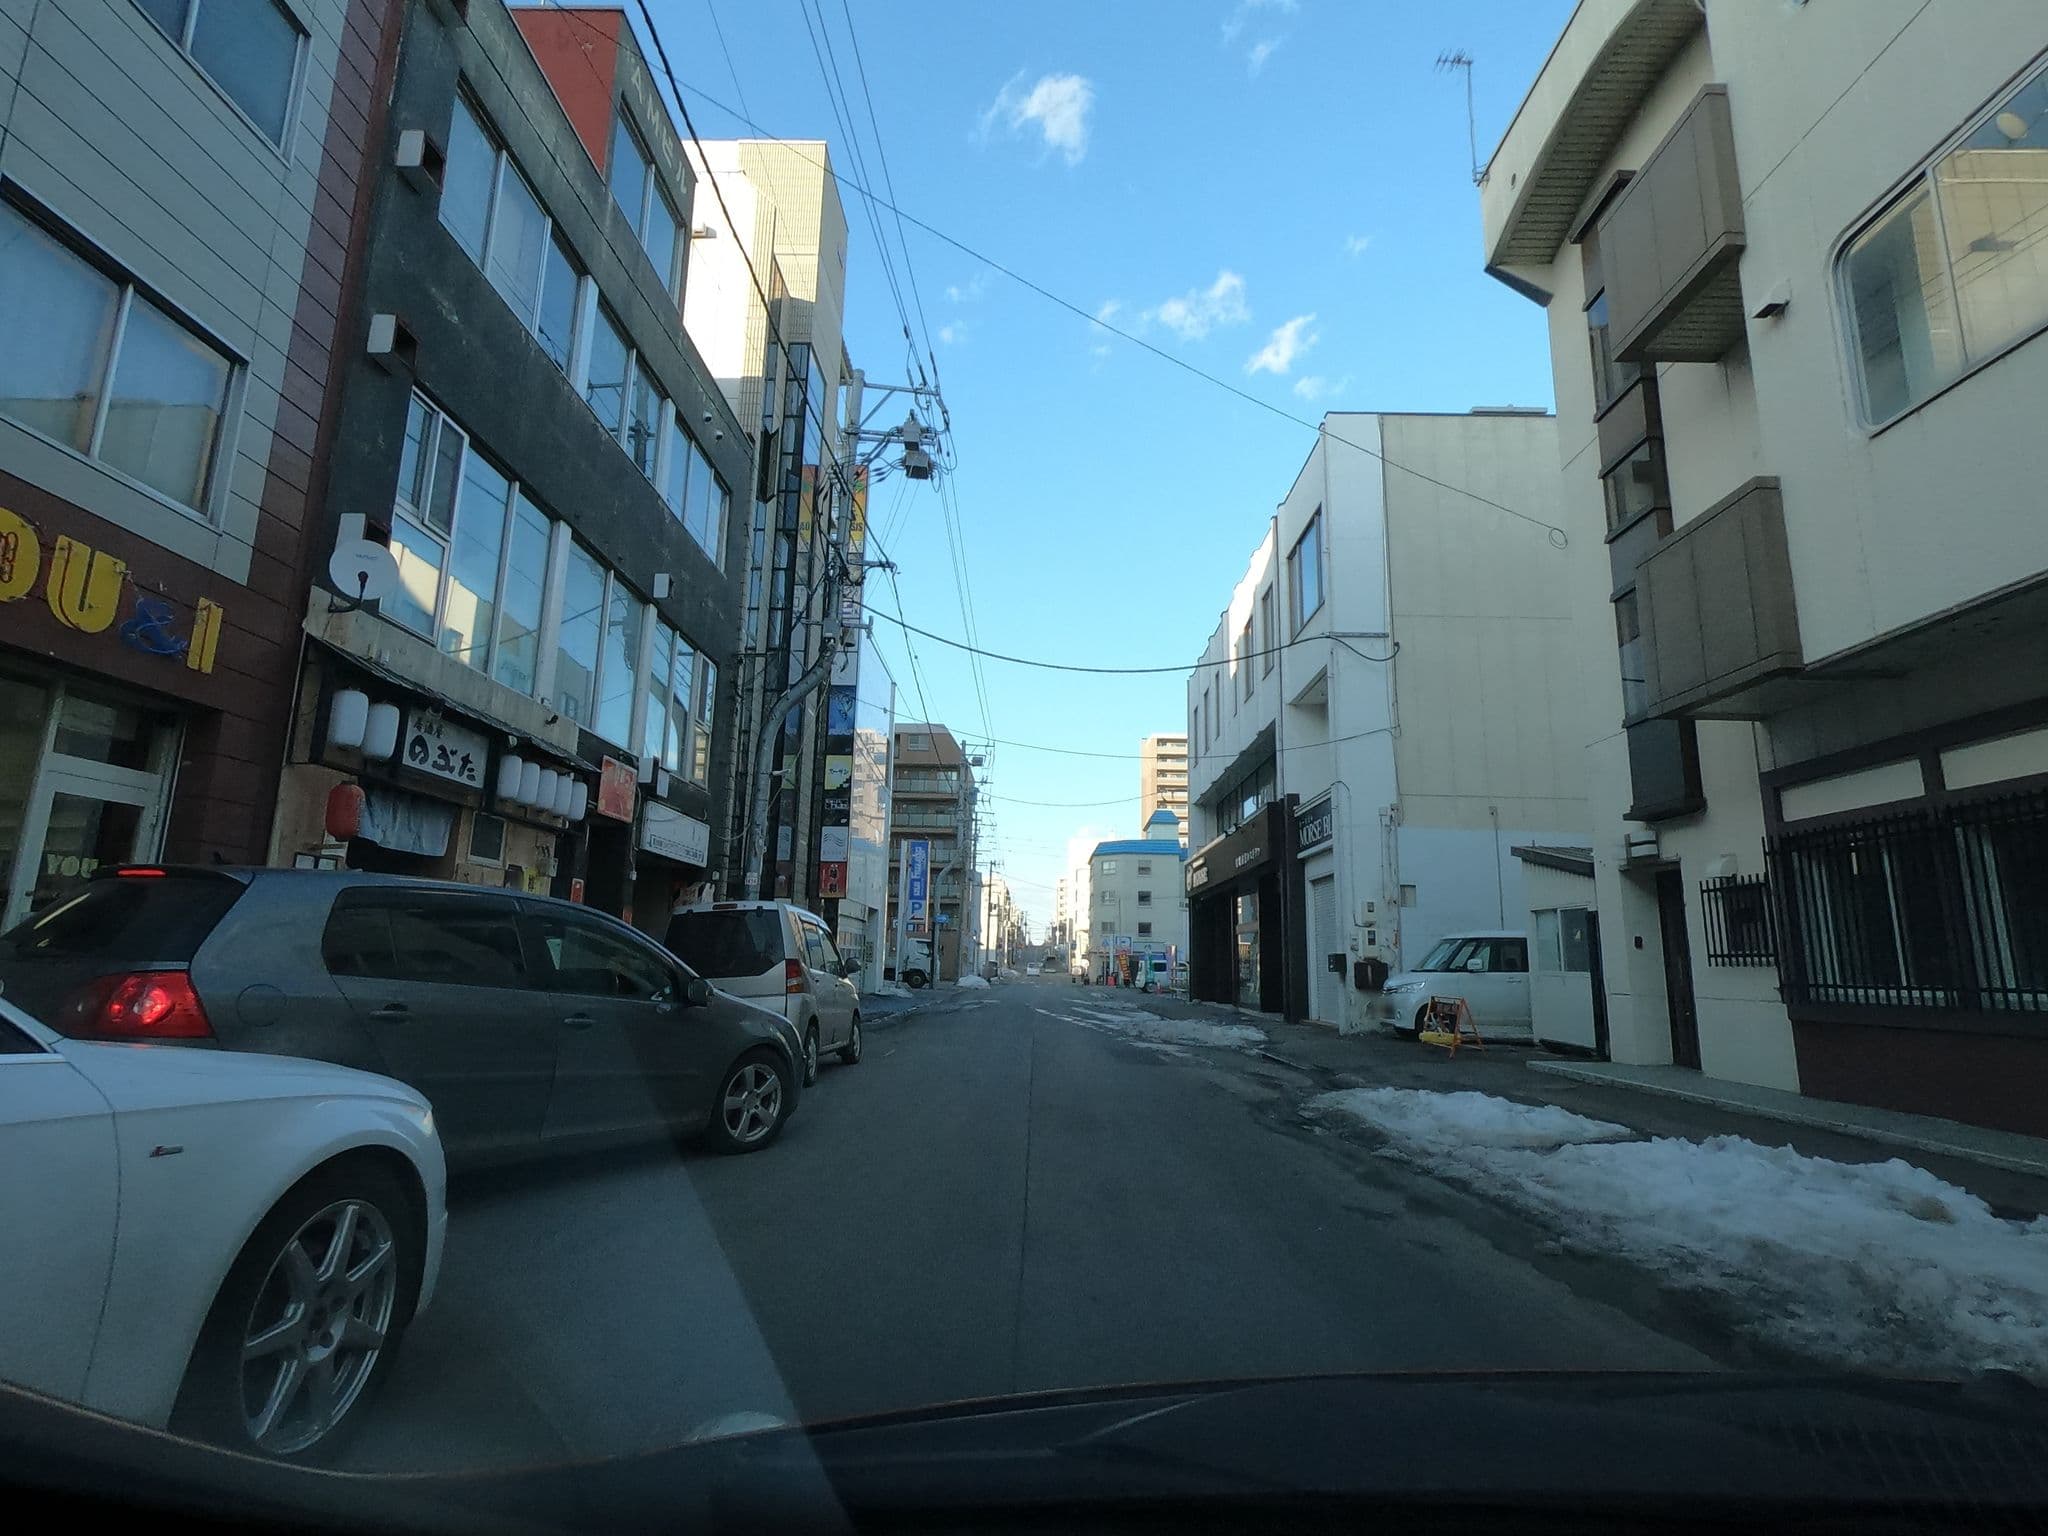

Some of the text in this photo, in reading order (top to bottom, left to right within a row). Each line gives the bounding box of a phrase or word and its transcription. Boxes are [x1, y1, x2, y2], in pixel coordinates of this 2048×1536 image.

[409, 735, 477, 781] のぶた
[47, 853, 99, 878] YOU
[911, 902, 922, 915] P
